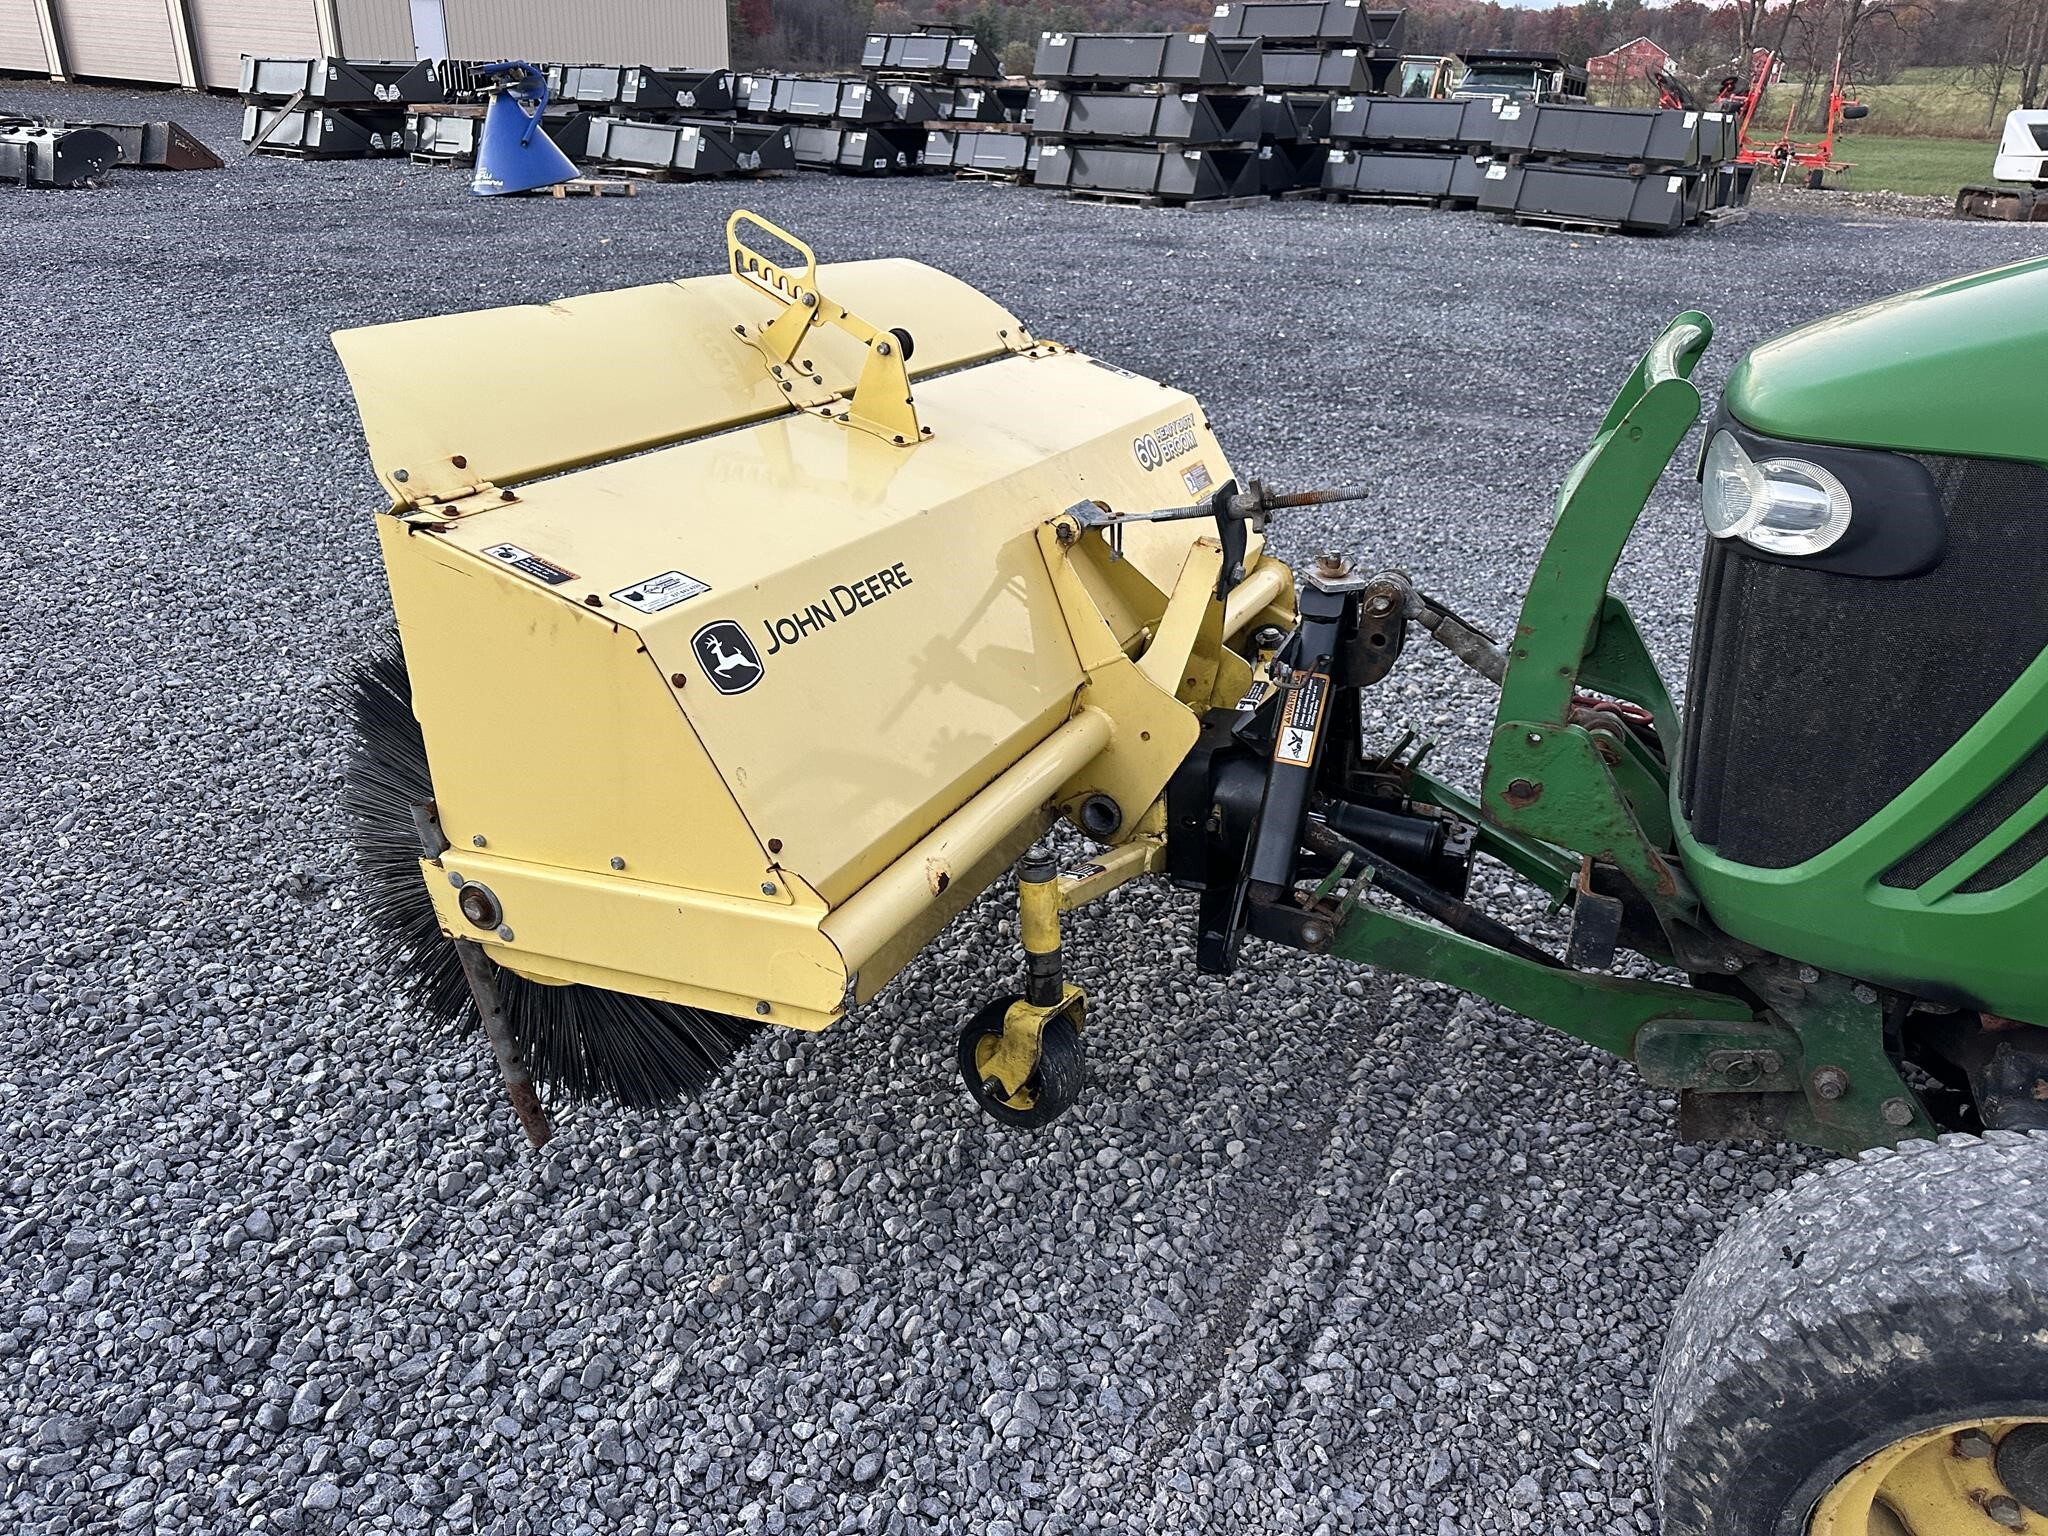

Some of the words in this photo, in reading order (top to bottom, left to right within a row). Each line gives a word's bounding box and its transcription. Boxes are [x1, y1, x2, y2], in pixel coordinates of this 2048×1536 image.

[1154, 420, 1178, 443] HEAVY
[1175, 413, 1196, 433] DUTY
[1133, 434, 1163, 472] 60
[1160, 430, 1198, 463] BROOM
[764, 599, 837, 655] JOHN
[829, 561, 913, 617] DEERE
